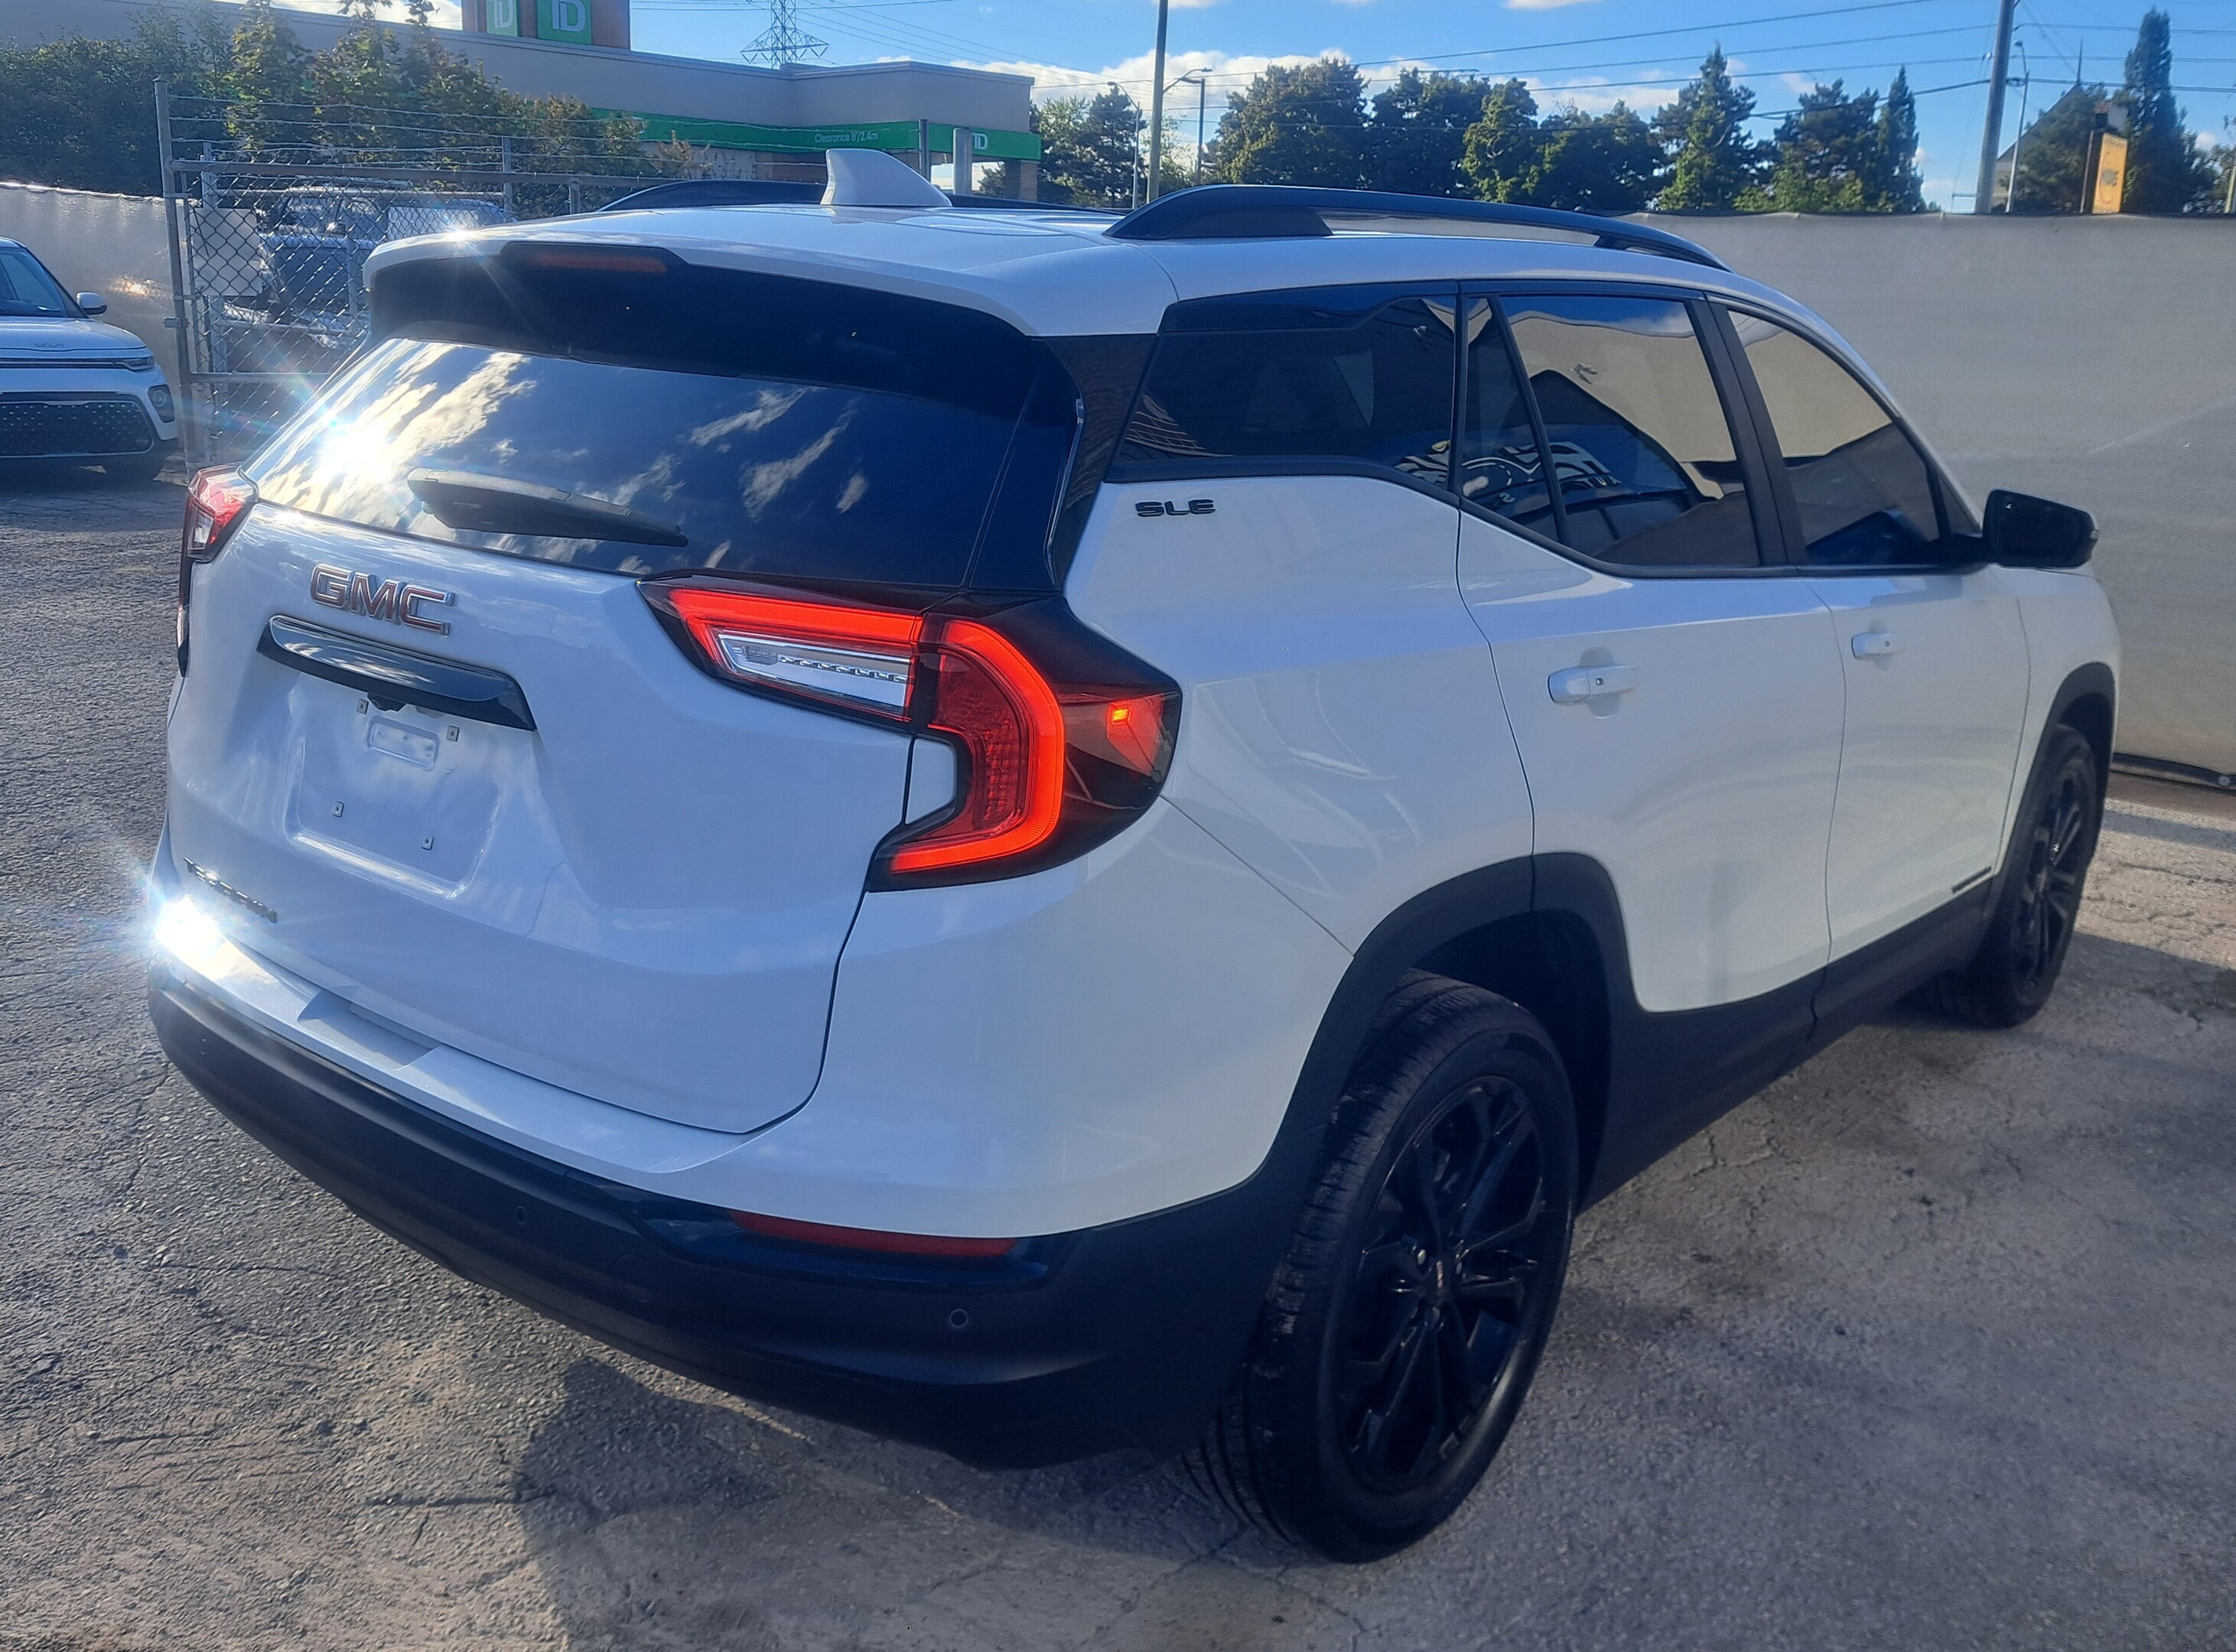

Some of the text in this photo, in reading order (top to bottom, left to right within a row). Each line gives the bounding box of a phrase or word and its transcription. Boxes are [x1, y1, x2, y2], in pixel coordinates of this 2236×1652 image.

[815, 133, 850, 143] Clearance
[972, 132, 988, 150] TD
[1135, 499, 1216, 517] SLE
[311, 563, 455, 636] GMC
